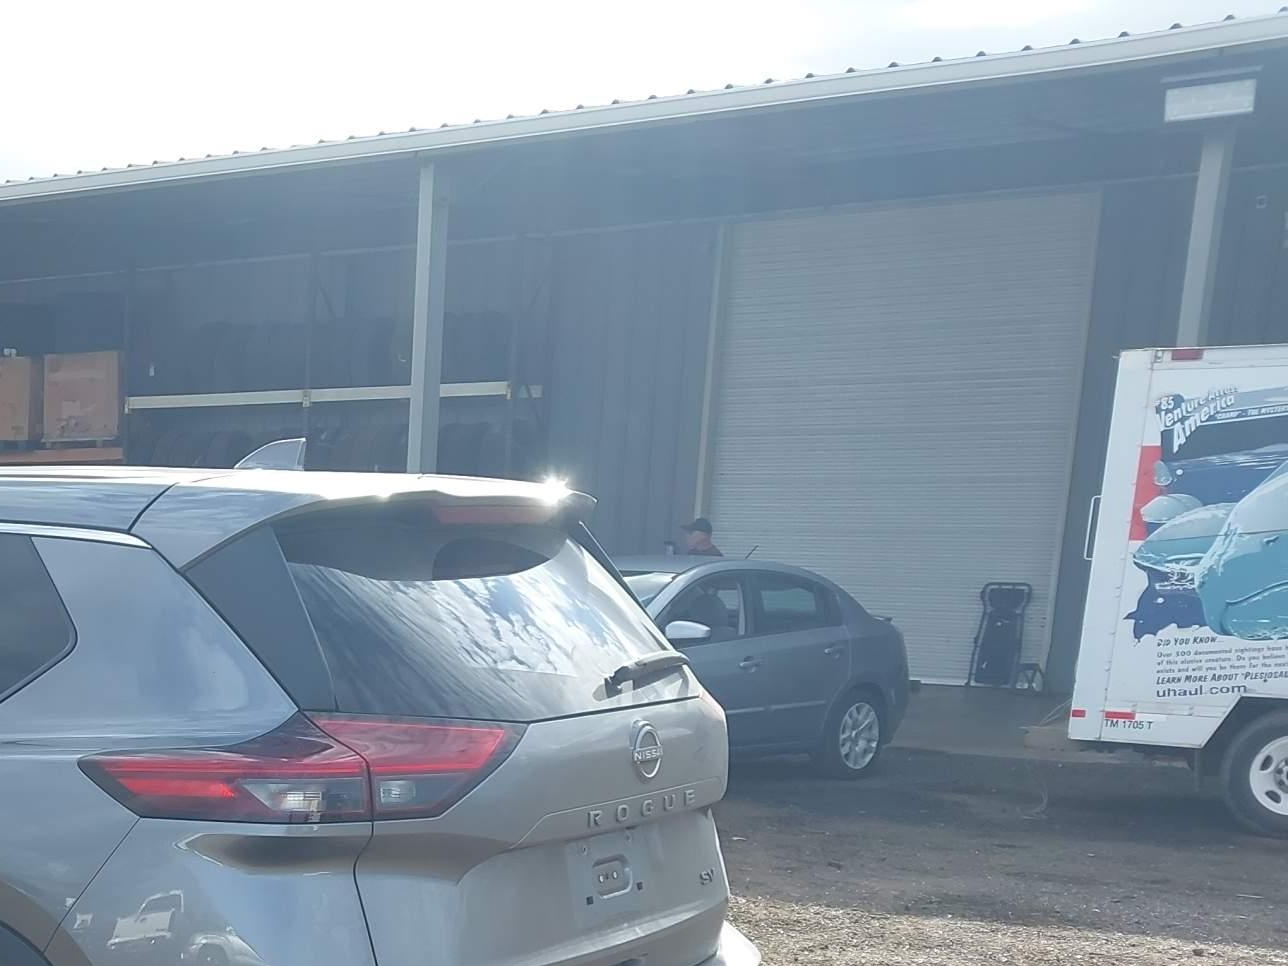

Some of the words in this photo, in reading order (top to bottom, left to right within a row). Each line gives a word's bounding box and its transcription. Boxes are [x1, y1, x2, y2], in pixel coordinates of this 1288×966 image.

[1173, 395, 1235, 454] America
[1156, 675, 1182, 685] LEARN
[1184, 674, 1209, 683] MORE
[1210, 672, 1240, 682] ABOUT
[1104, 719, 1119, 728] TM
[1123, 720, 1145, 730] 1705
[1147, 721, 1154, 730] T
[587, 789, 697, 829] ROGUE
